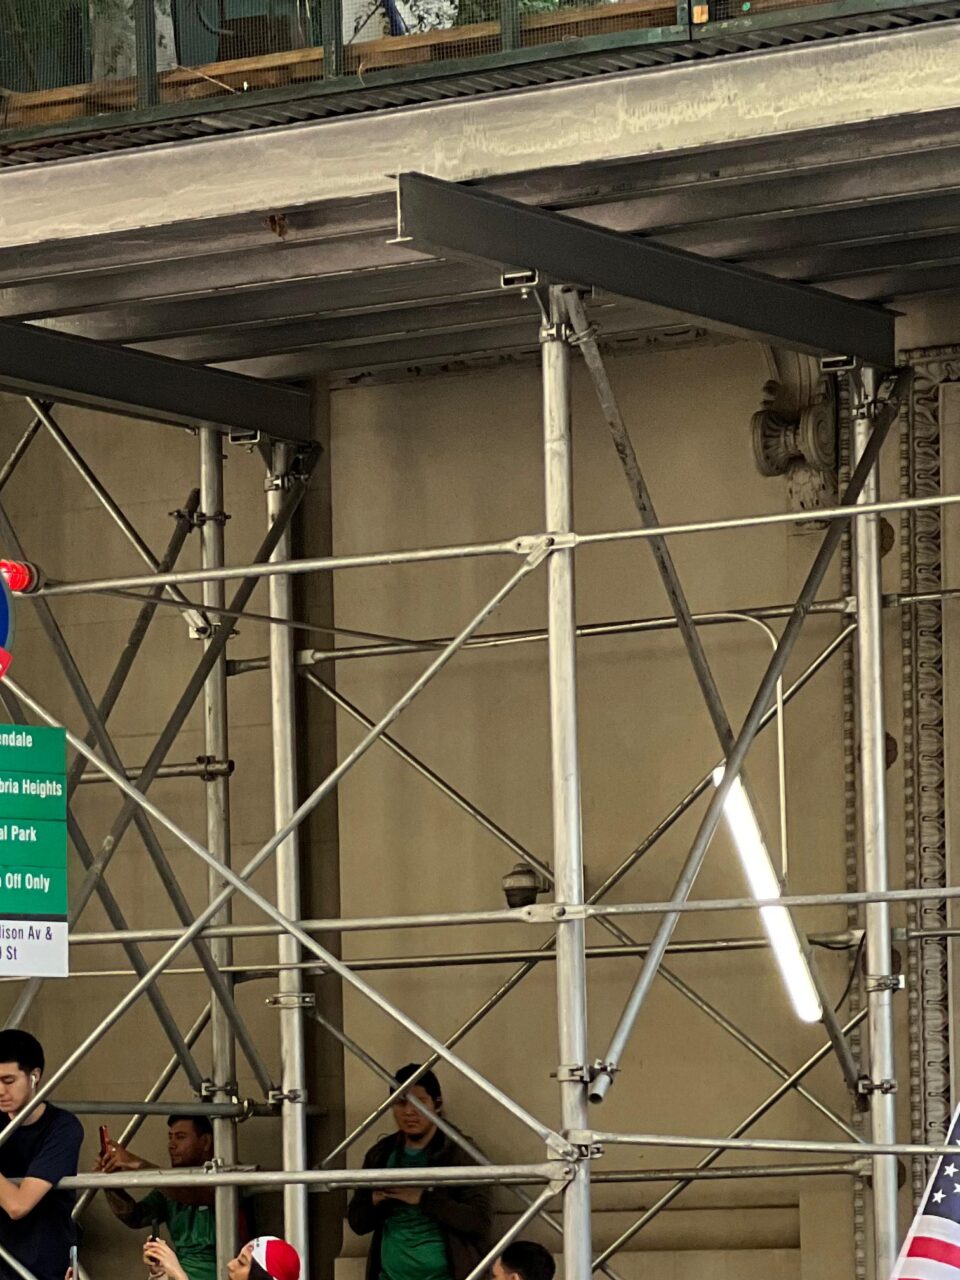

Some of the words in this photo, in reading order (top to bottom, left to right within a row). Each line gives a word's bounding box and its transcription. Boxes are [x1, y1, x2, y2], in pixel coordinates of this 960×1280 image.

[22, 779, 62, 798] Heights
[11, 825, 37, 842] Park
[5, 872, 22, 889] Off
[25, 873, 50, 893] Only
[28, 925, 41, 941] Av
[45, 926, 53, 941] &
[6, 945, 18, 960] St
